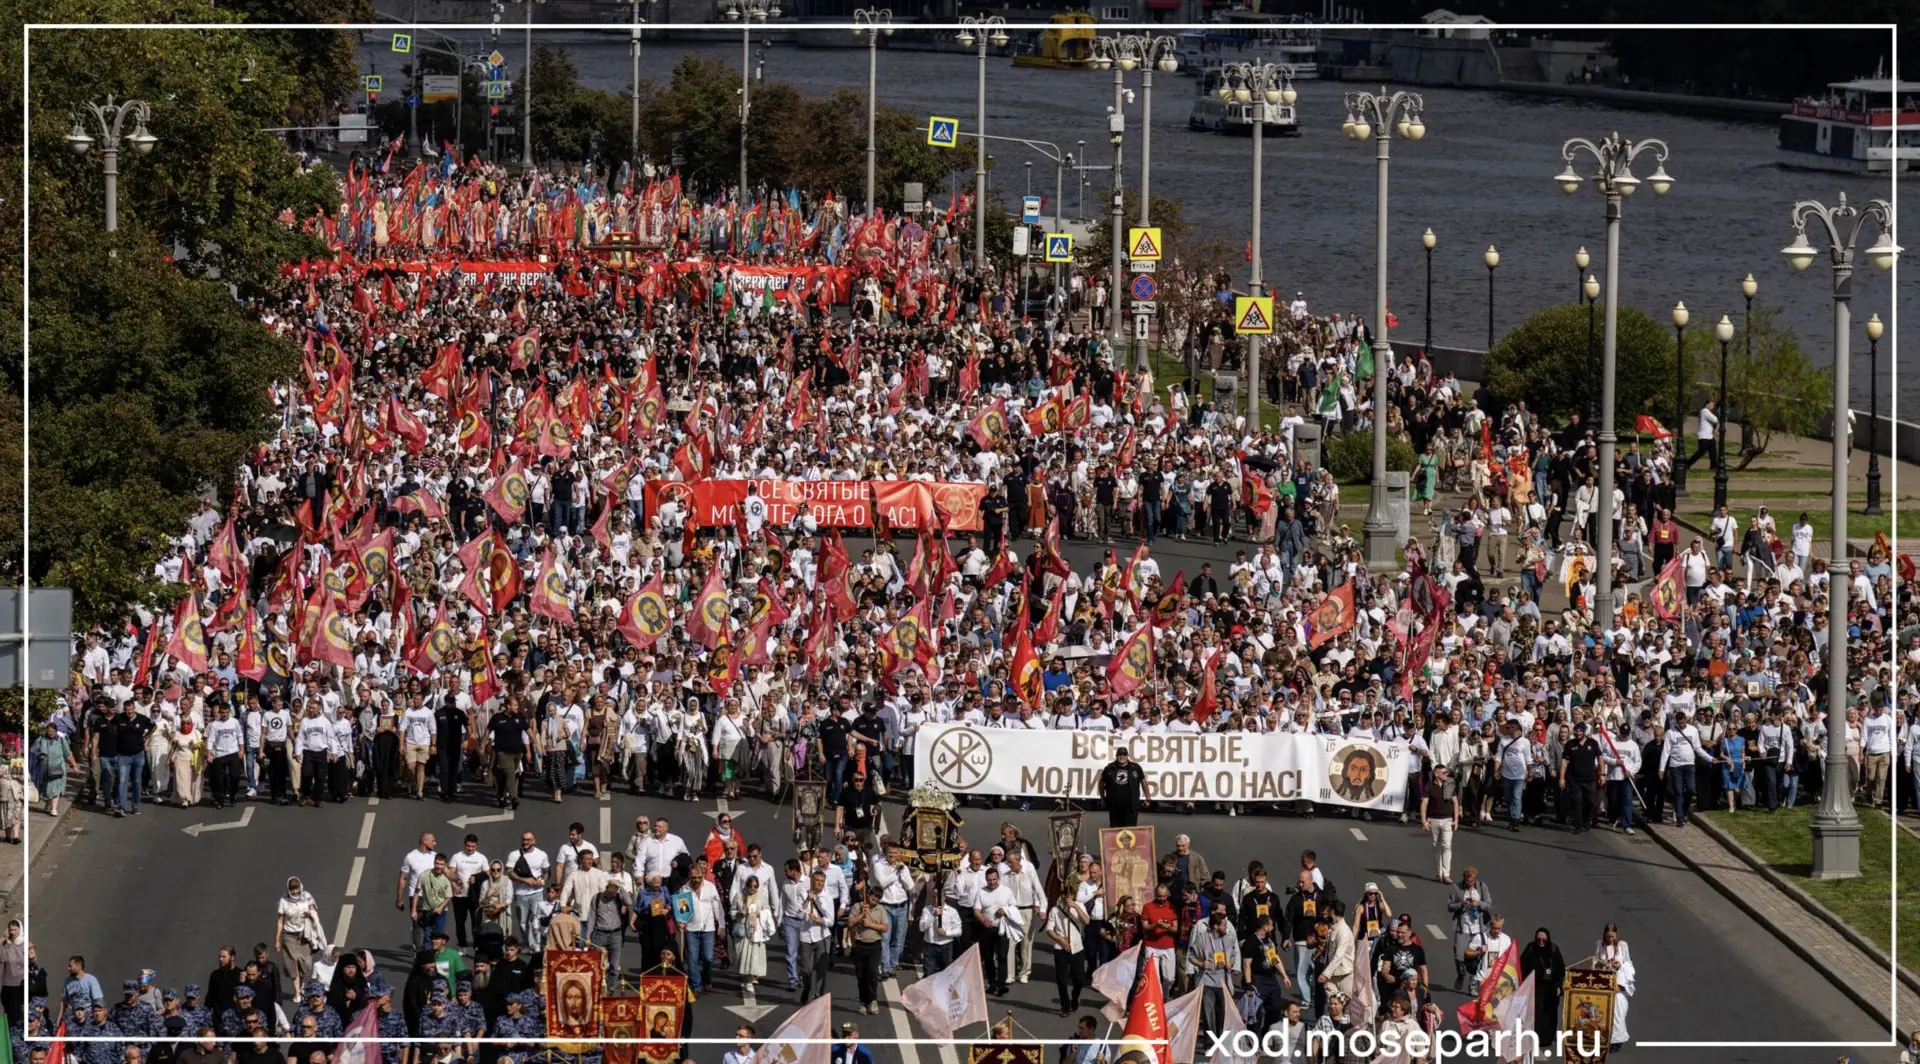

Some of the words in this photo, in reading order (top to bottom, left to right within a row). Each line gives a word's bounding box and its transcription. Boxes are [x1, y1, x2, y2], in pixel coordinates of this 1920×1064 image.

[790, 481, 870, 500] СВЯТЫЕ
[813, 504, 846, 525] ОГА
[853, 505, 865, 526] О
[887, 506, 916, 527] АС!
[1072, 732, 1123, 761] ВСЕ
[1128, 734, 1249, 768] СВЯТЫЕ,
[1020, 765, 1106, 796] МОЛИ
[1142, 770, 1209, 798] БОГА
[1215, 771, 1233, 799] О
[1240, 769, 1302, 799] НАС!
[1143, 1002, 1162, 1032] МЫ
